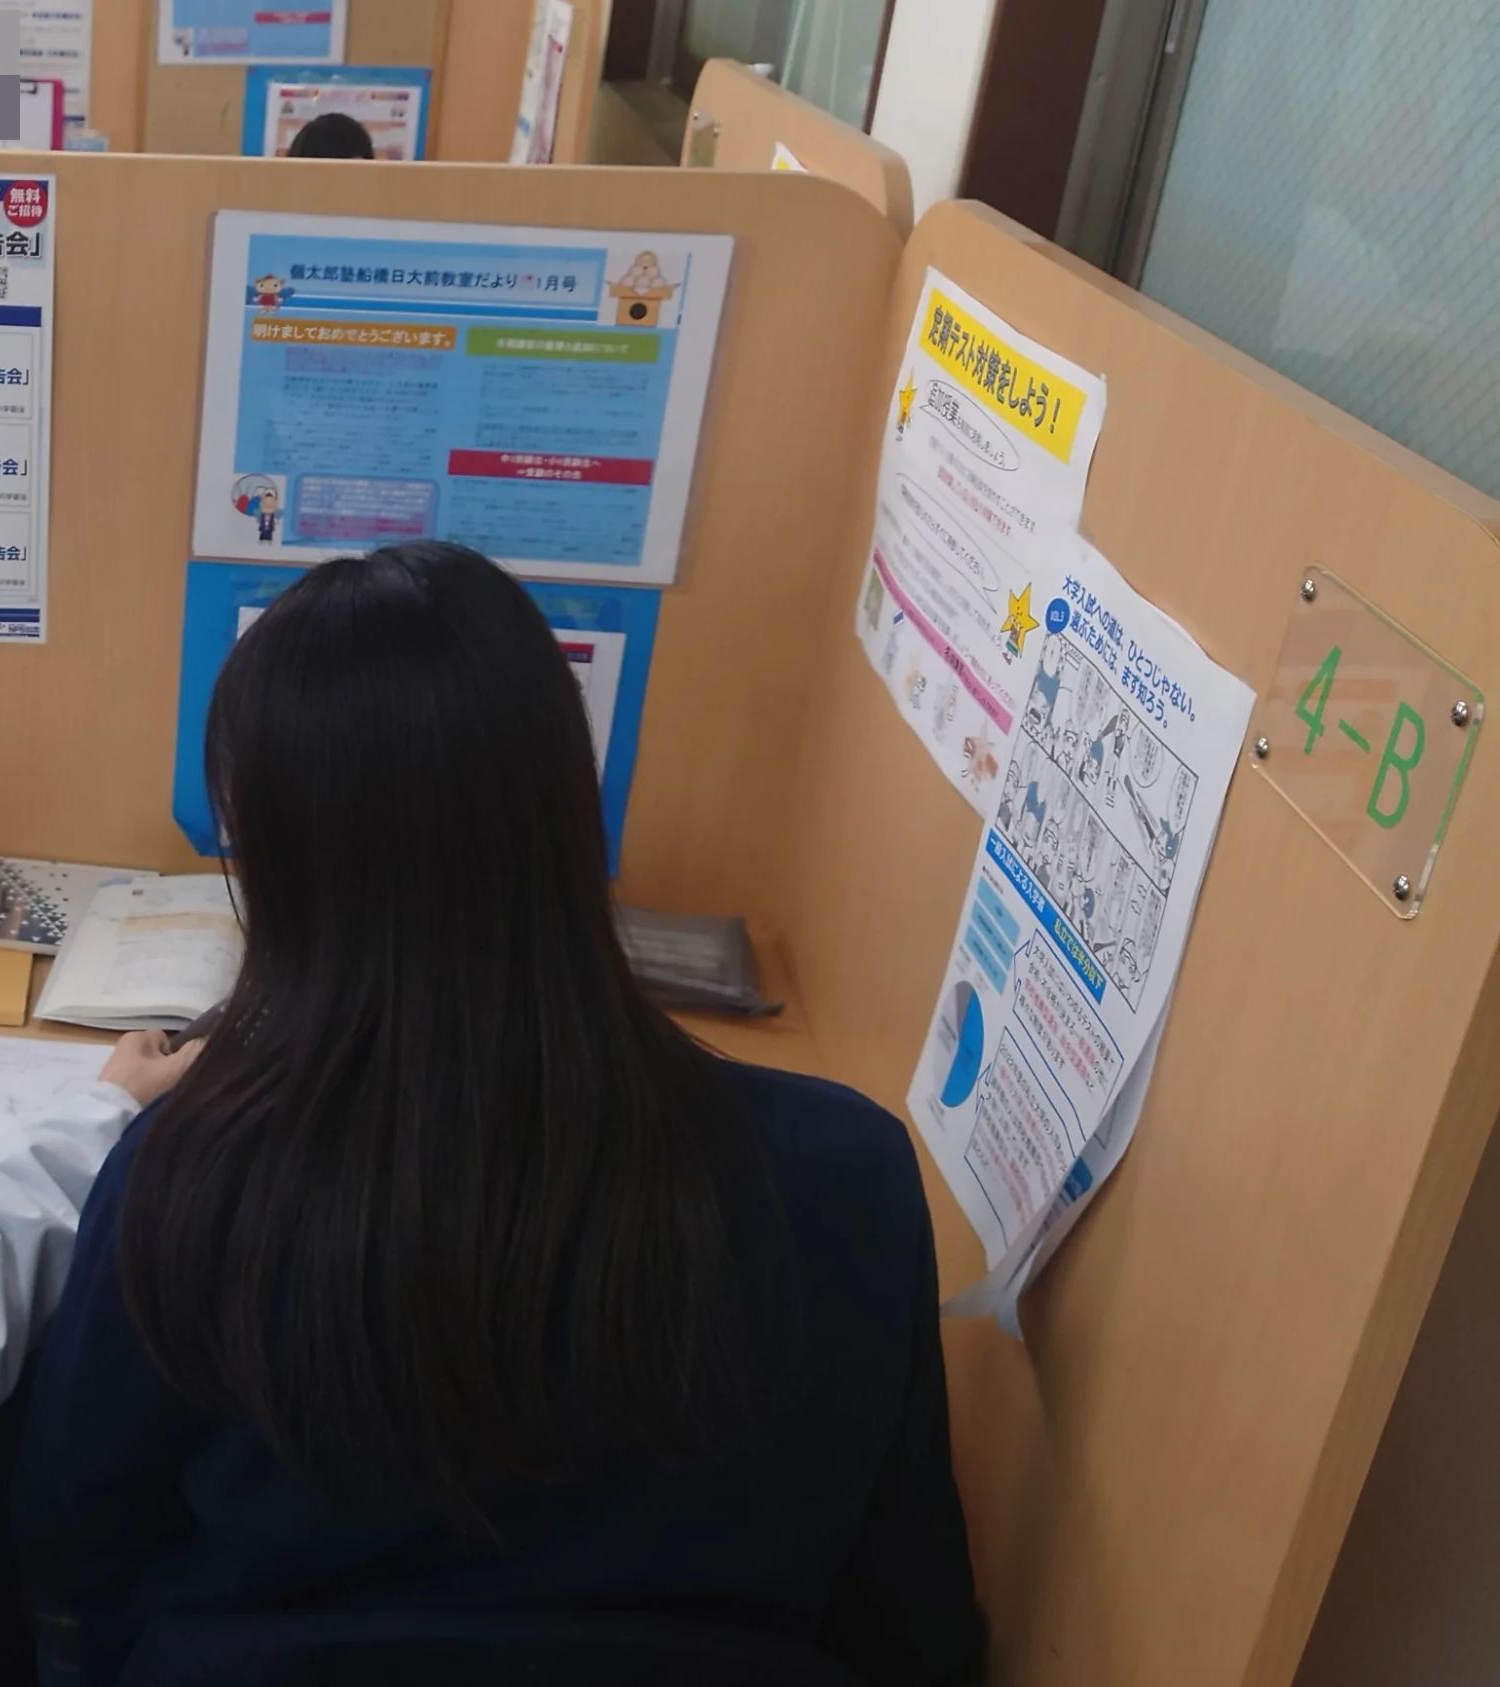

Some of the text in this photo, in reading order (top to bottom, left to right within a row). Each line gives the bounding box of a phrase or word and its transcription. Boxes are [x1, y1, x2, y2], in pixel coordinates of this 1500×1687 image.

[9, 187, 42, 204] 無料
[7, 204, 42, 217] ご招待
[290, 263, 518, 290] 個太郎塾船橋日大前教室だより
[251, 323, 453, 348] 明けましておめでとうございます。
[928, 304, 1061, 433] 定期テスト対策をしよう！
[1295, 645, 1426, 829] 4-B
